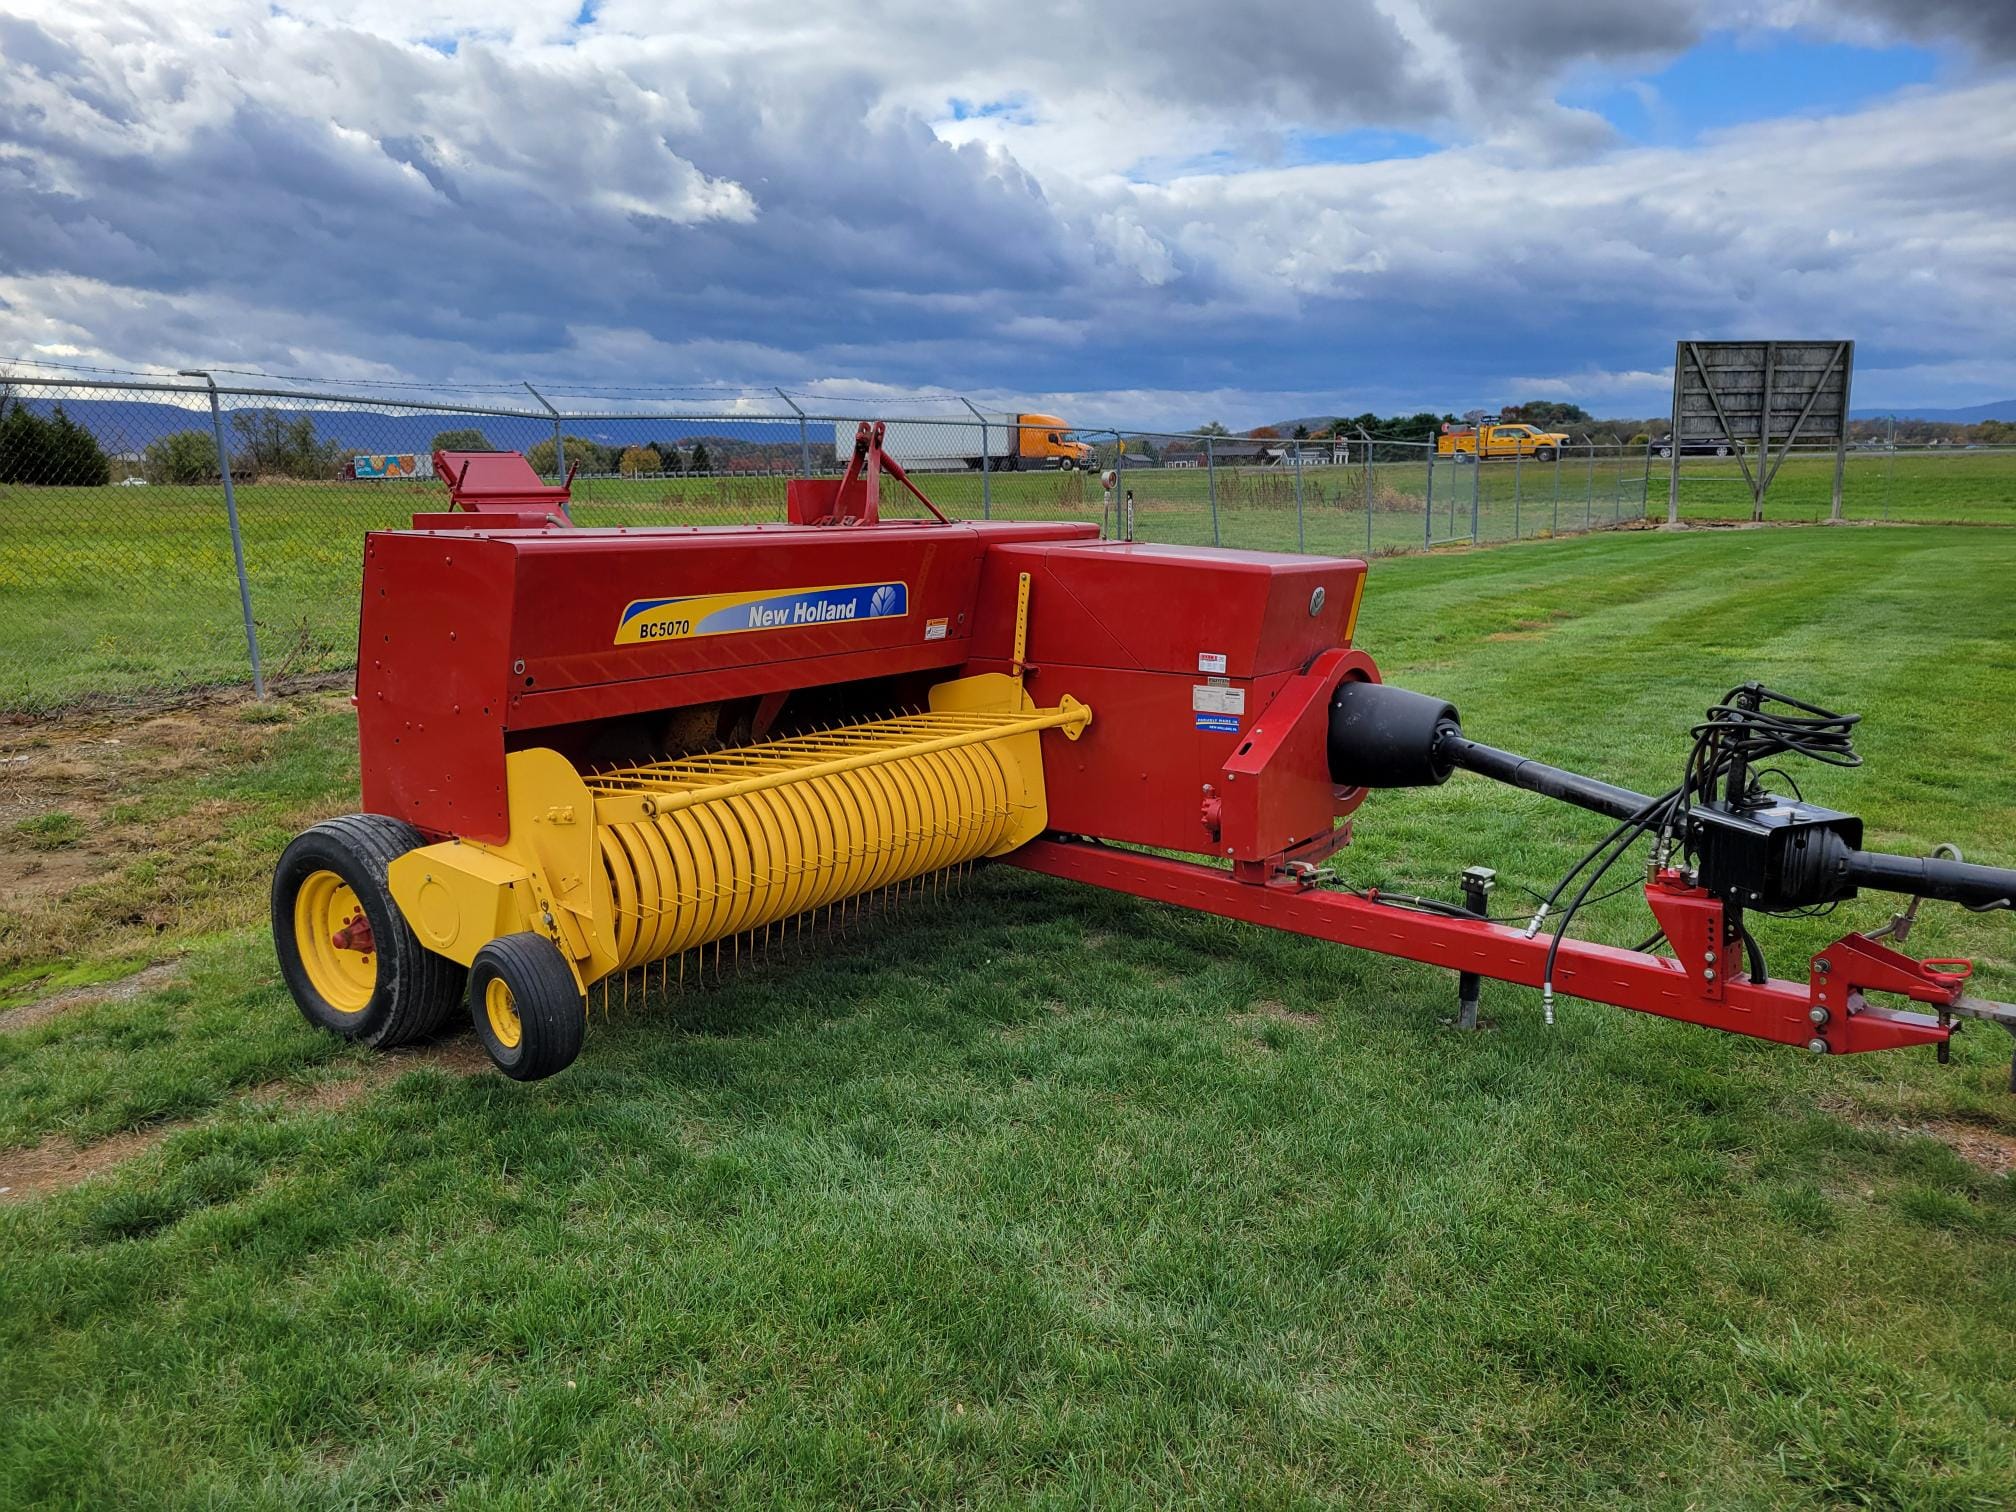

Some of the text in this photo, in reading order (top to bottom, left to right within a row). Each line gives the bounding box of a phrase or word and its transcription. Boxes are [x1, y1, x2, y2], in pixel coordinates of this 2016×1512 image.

[748, 598, 857, 628] New Holland
[639, 619, 690, 639] BC5070
